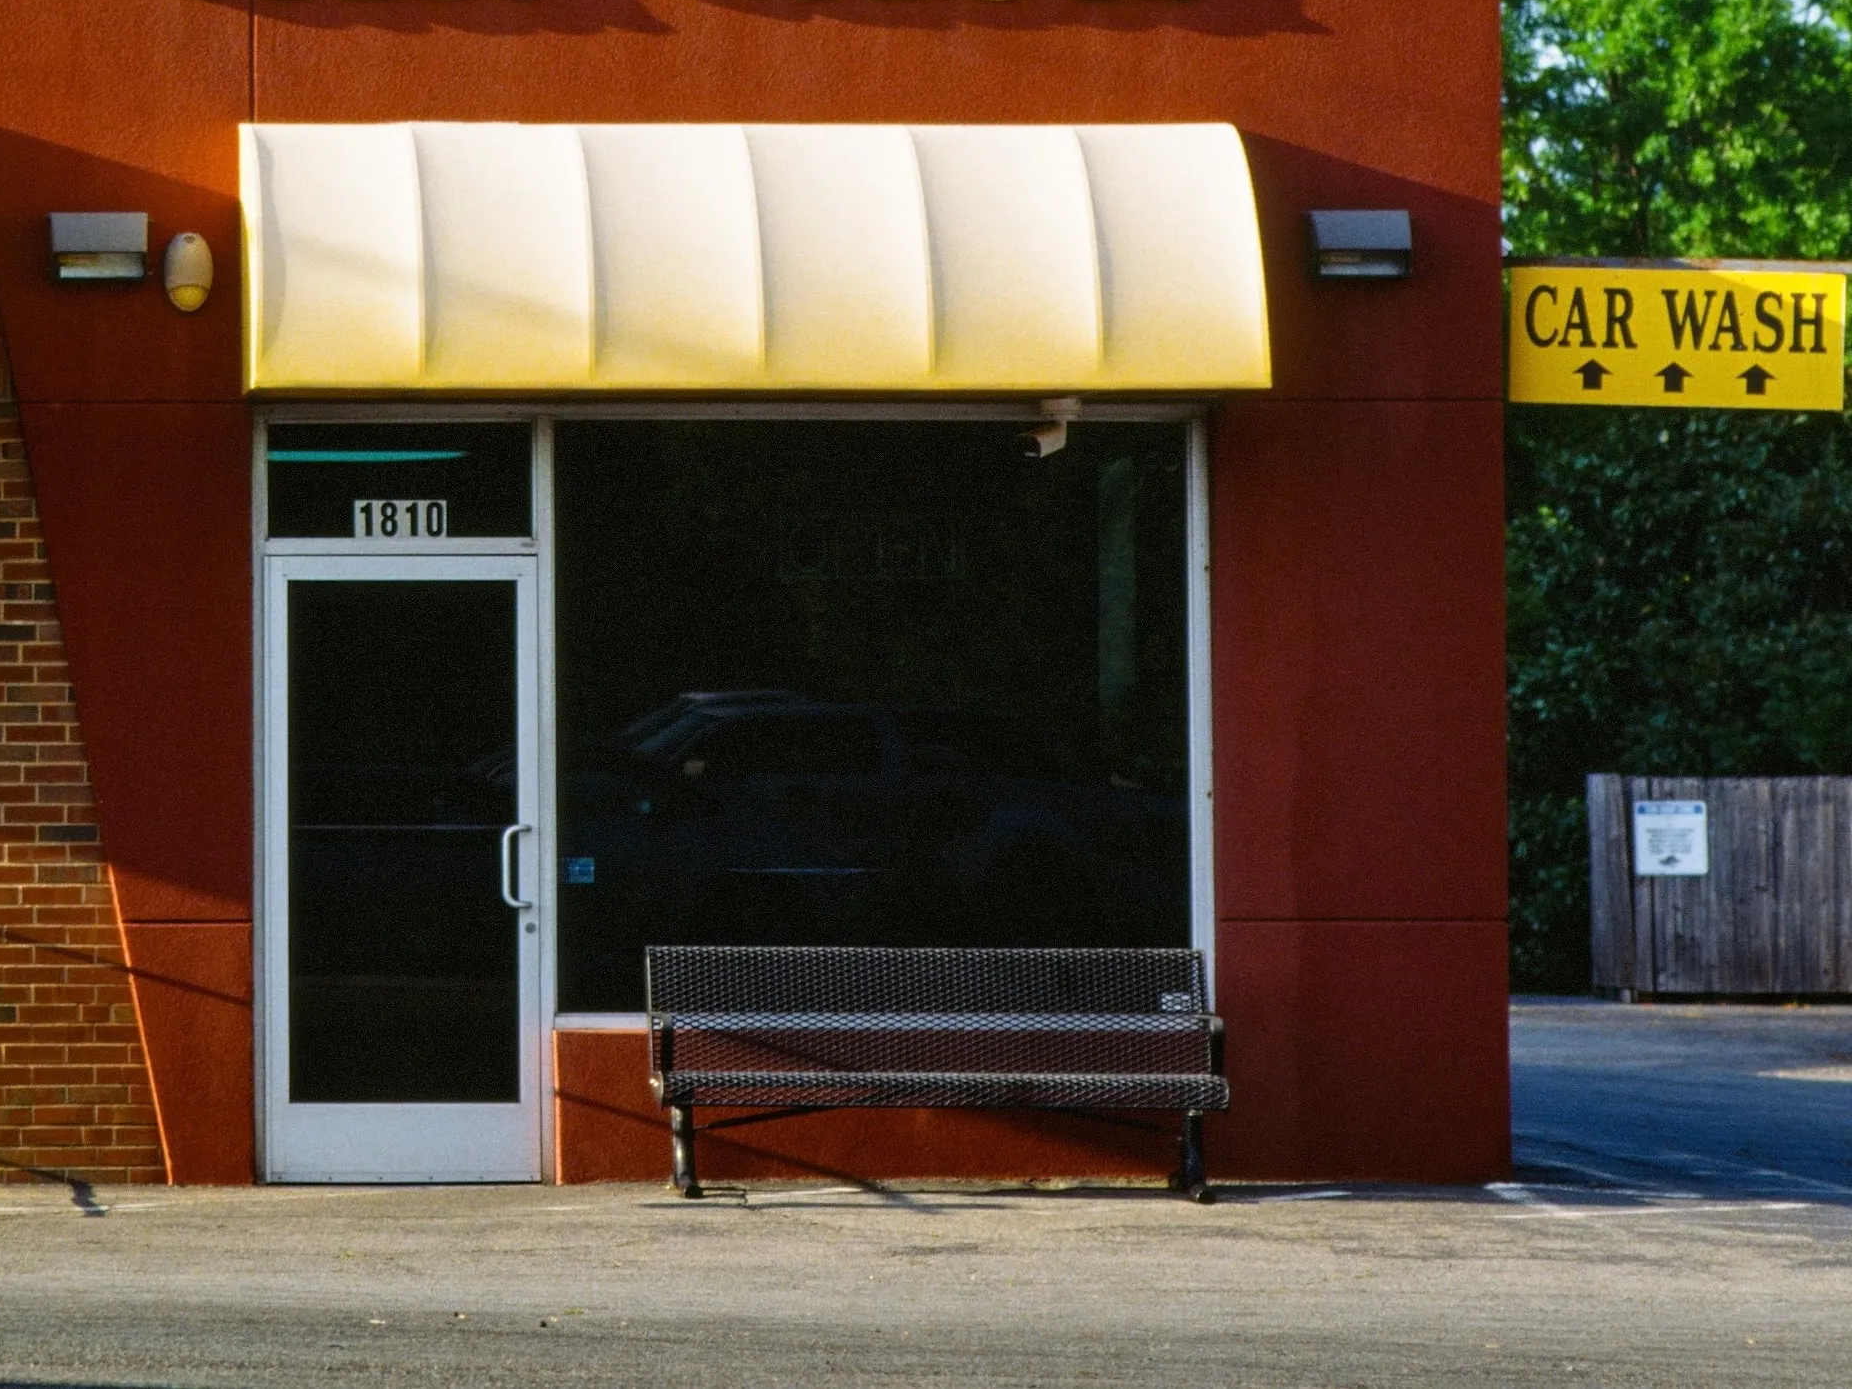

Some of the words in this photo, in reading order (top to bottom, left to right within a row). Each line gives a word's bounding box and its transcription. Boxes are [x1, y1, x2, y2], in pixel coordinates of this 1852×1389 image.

[1525, 284, 1637, 349] CAR
[1661, 288, 1828, 354] WASH
[358, 501, 445, 537] 1810
